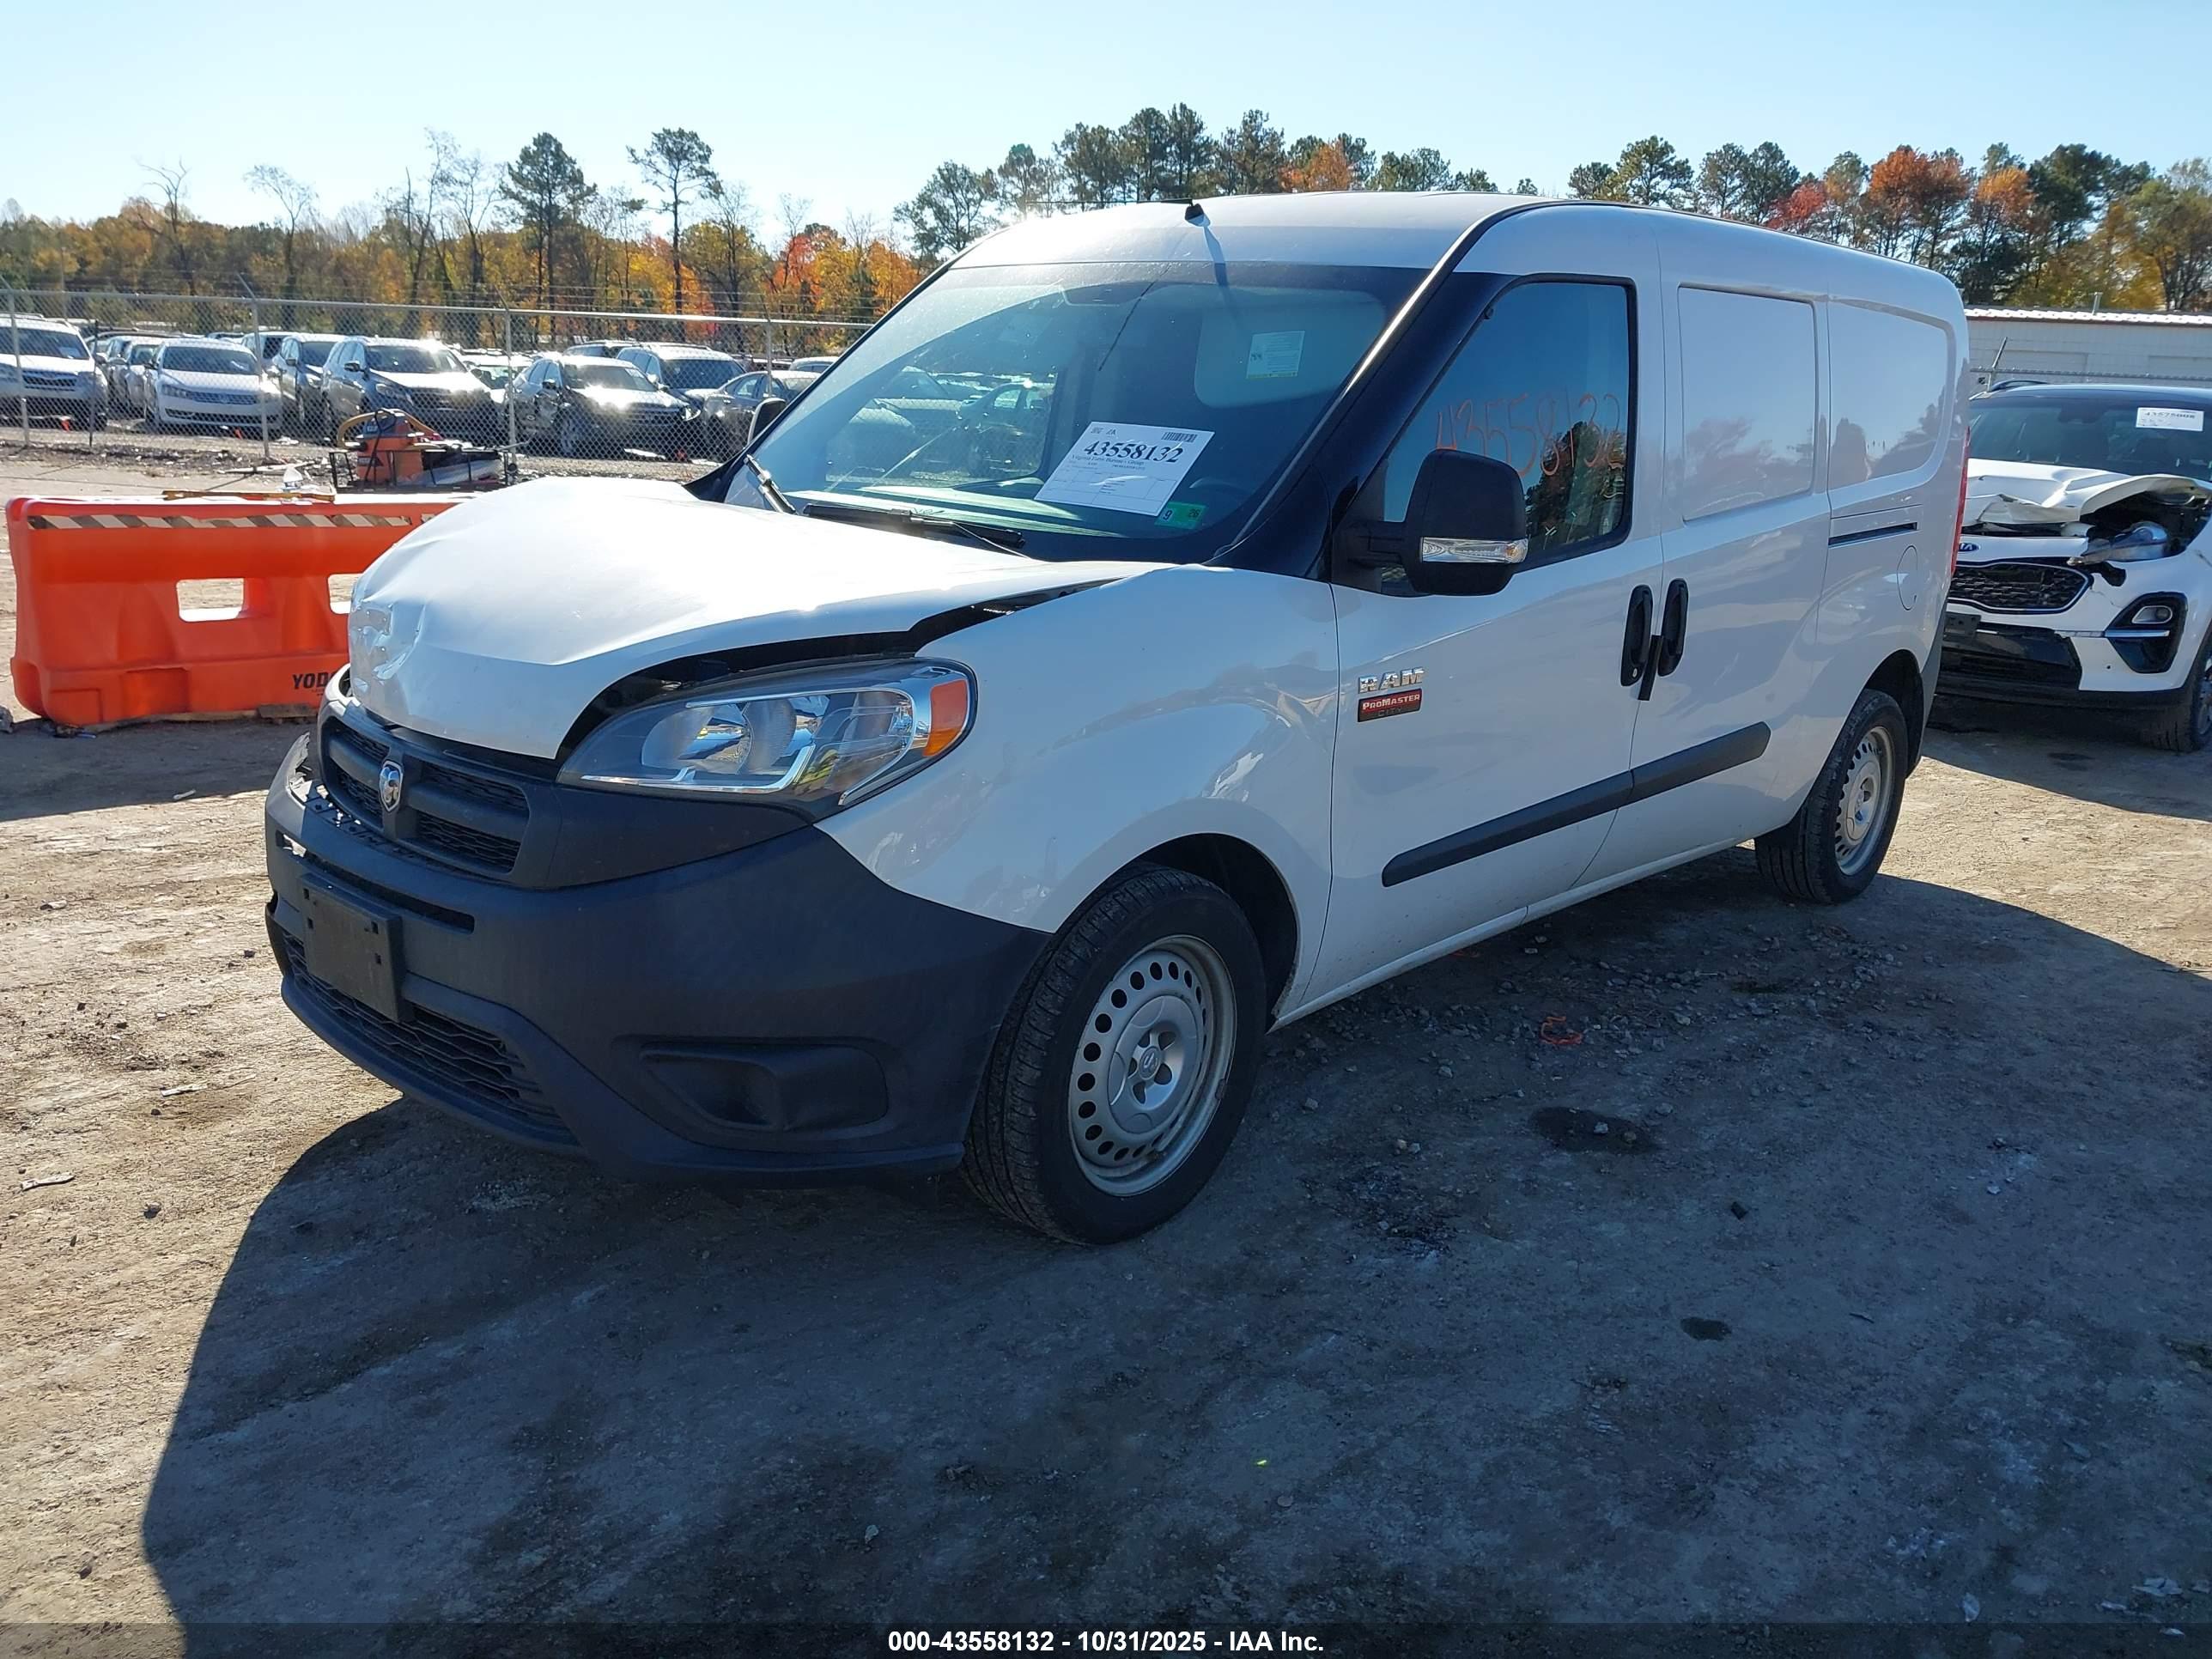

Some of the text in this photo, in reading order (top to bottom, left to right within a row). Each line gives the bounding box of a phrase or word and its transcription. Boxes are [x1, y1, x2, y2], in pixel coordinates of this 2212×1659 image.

[1084, 441, 1183, 463] 43558132
[1163, 510, 1173, 520] 9
[1358, 666, 1425, 694] RAM
